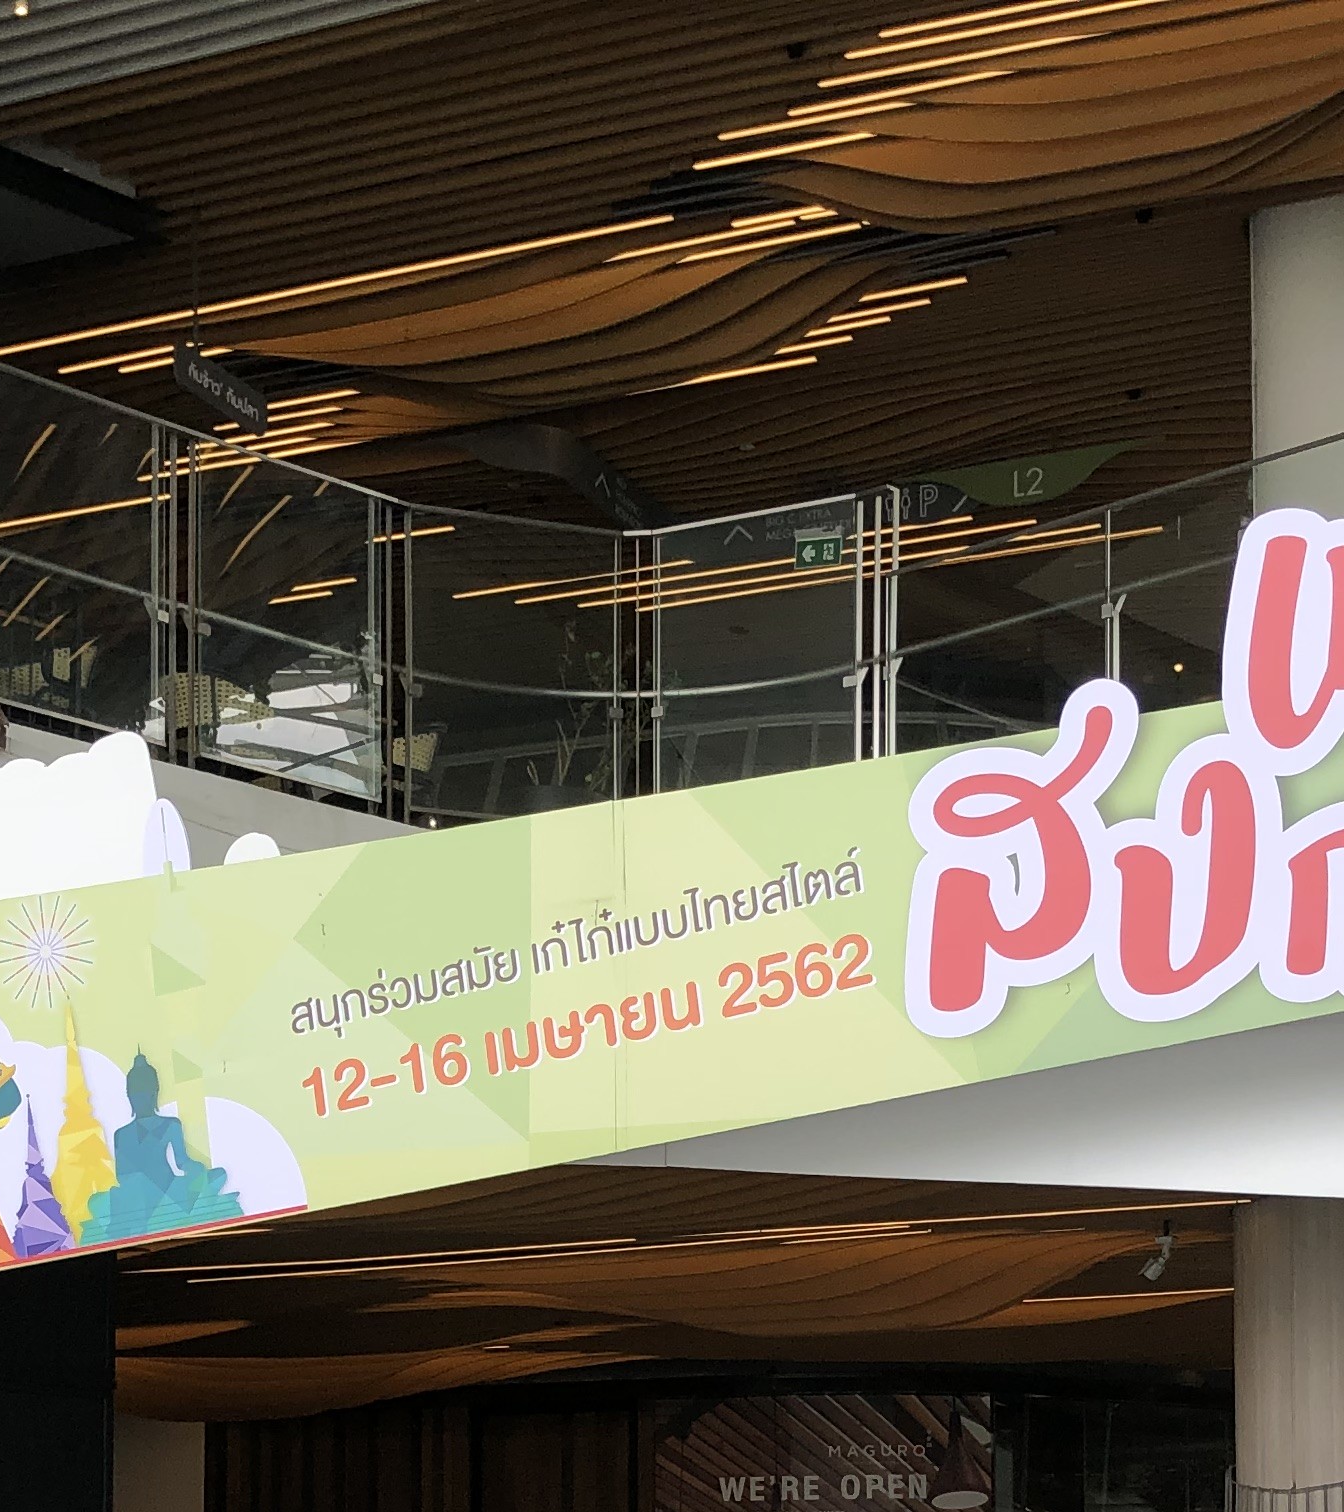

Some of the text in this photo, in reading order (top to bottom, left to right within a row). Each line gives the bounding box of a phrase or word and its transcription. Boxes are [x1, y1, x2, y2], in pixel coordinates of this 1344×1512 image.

[1013, 467, 1044, 498] L2
[290, 943, 519, 1037] สนุกร่วมสมัย
[301, 933, 875, 1118] 12-16 เมษายน 2562
[828, 1444, 926, 1458] MAGURO
[718, 1474, 928, 1502] WE'RE OPEN
